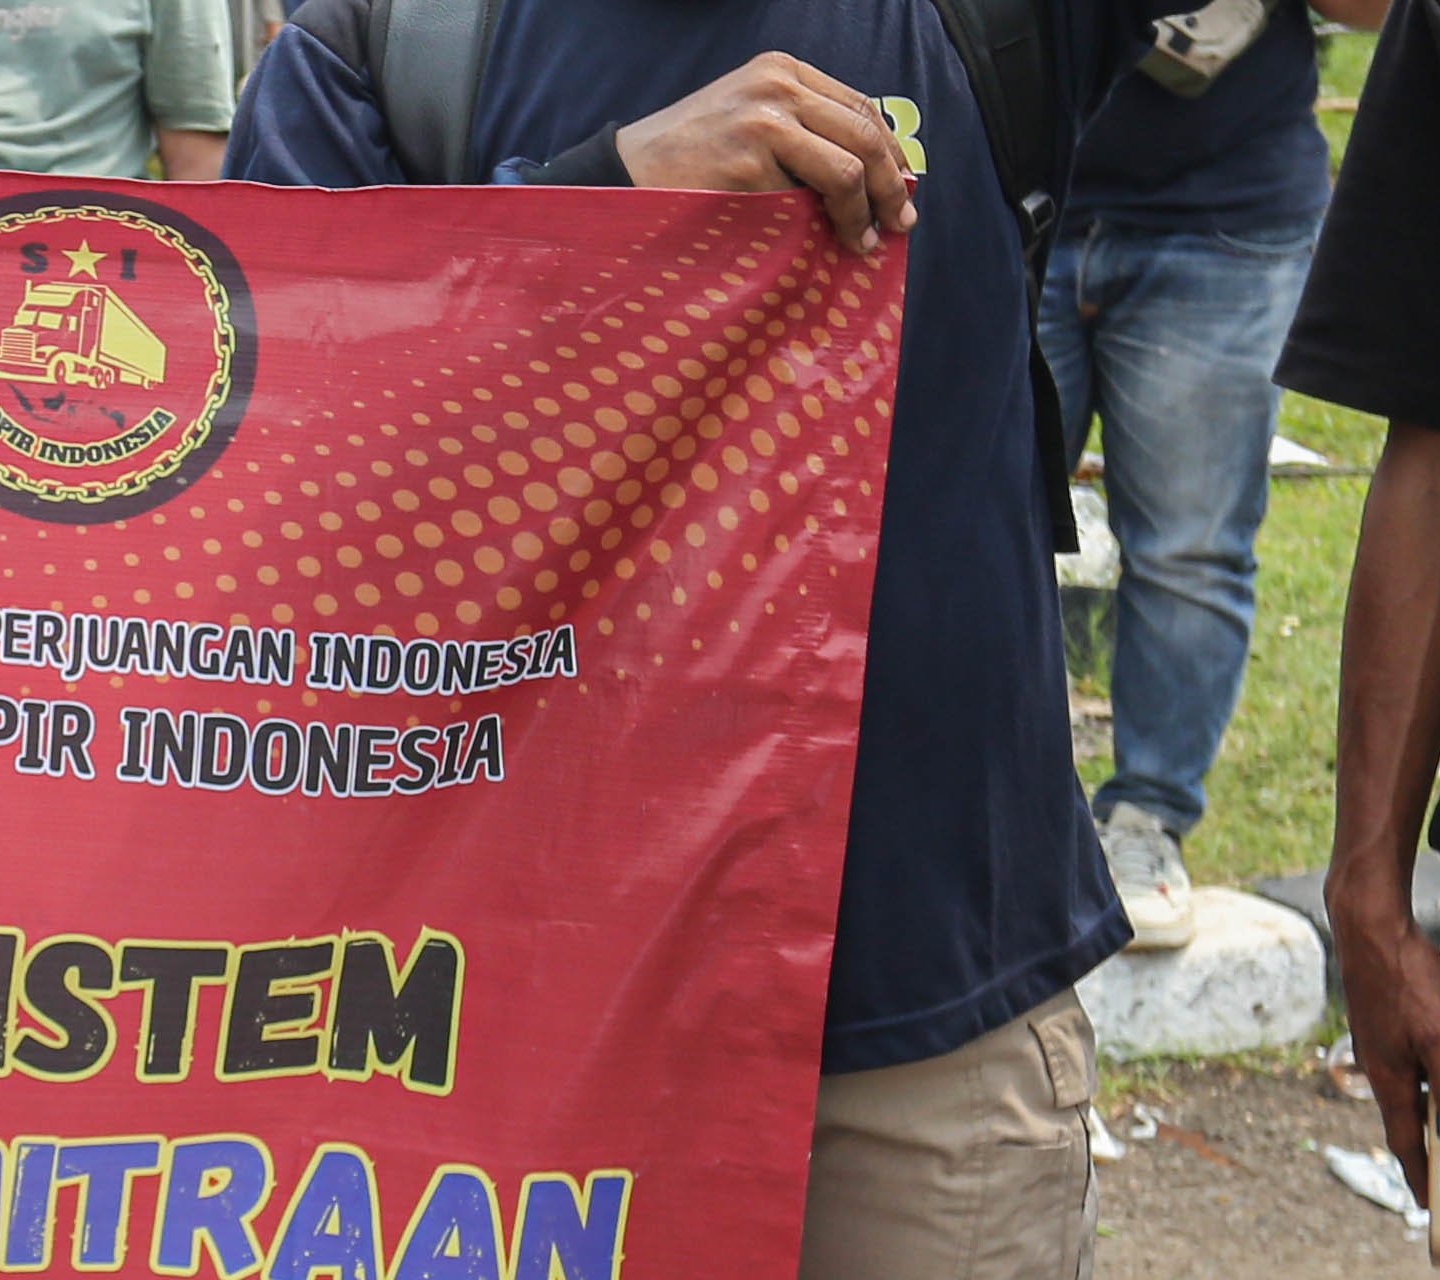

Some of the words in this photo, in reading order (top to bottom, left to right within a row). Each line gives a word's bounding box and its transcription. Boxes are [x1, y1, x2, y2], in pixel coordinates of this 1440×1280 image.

[19, 242, 50, 274] S
[119, 248, 138, 281] I
[37, 408, 175, 465] INDONESIA
[305, 623, 579, 697] INDONESIA
[114, 708, 508, 798] INDONESIA
